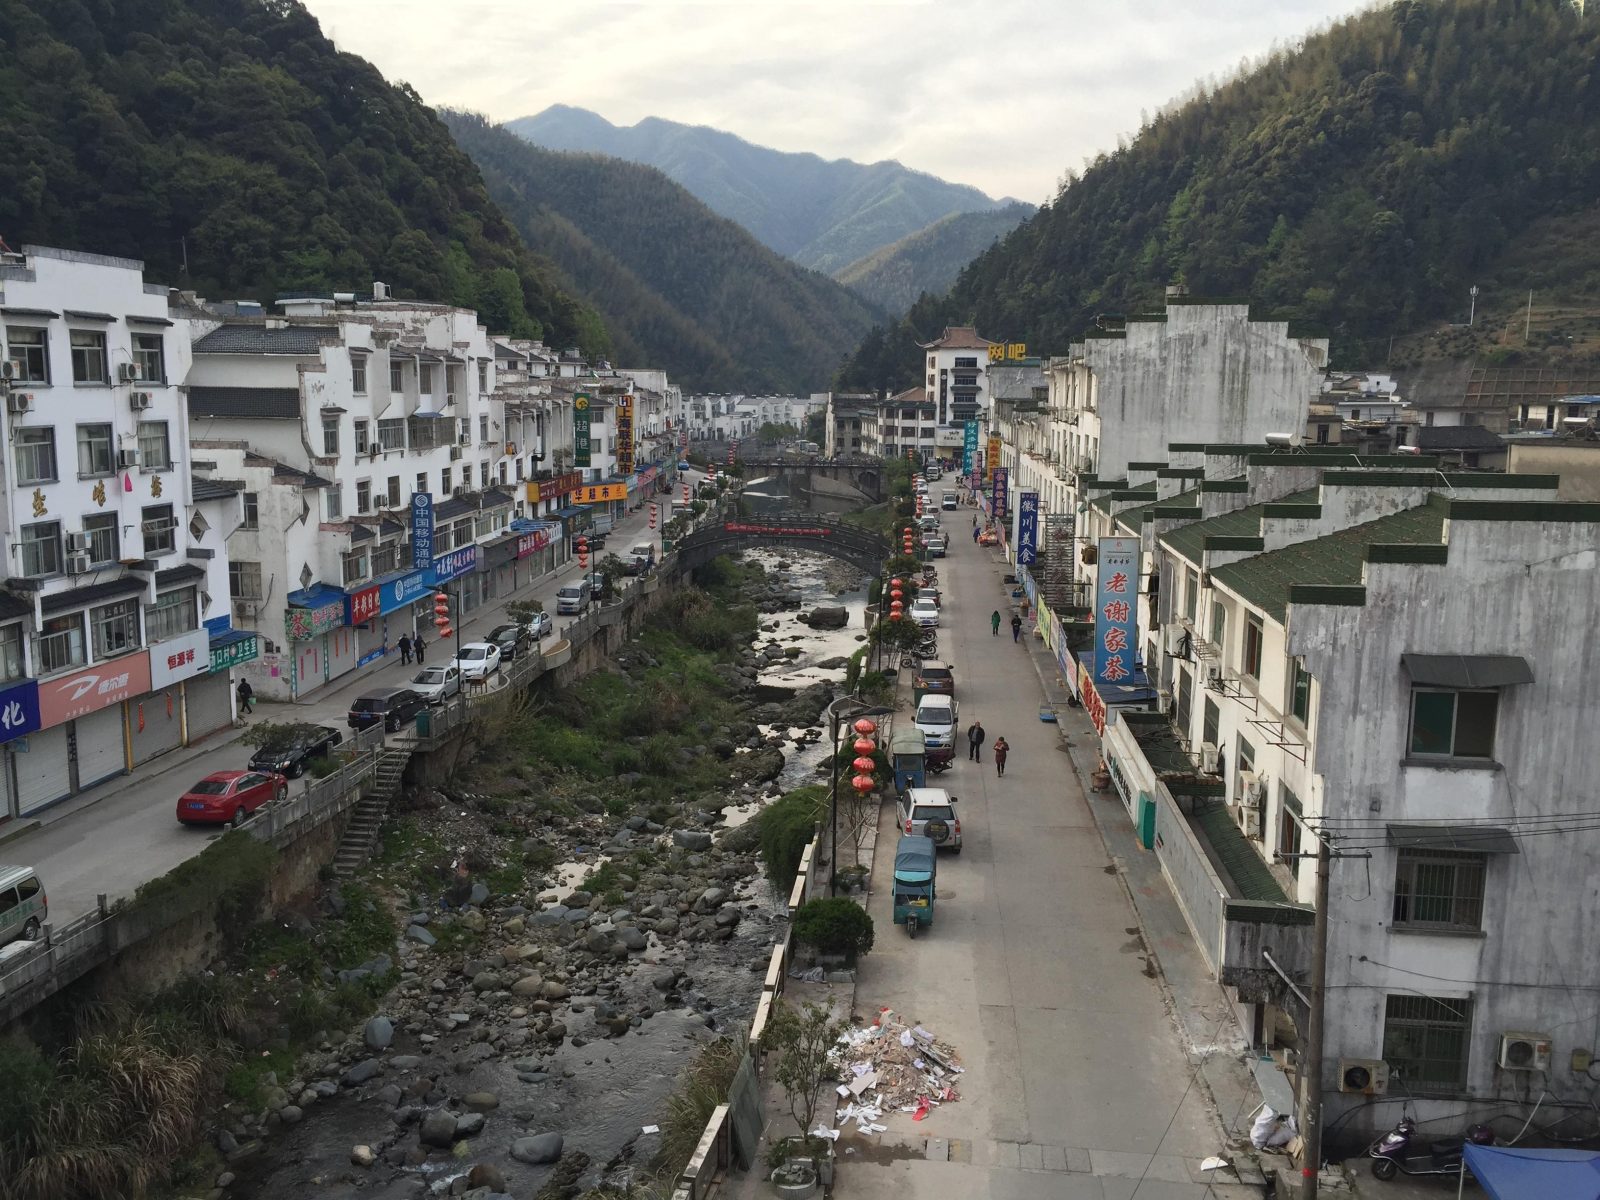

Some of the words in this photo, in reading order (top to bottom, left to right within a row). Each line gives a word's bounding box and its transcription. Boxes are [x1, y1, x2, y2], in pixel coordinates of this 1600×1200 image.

[989, 344, 1025, 361] 网吧
[619, 407, 632, 473] 上海联华超市
[415, 507, 430, 568] 中国移动通信
[1019, 501, 1037, 563] 徽川美食
[291, 612, 311, 638] 茶
[1101, 572, 1131, 681] 老谢家茶
[167, 648, 195, 670] 恒源祥
[1, 700, 25, 730] 化
